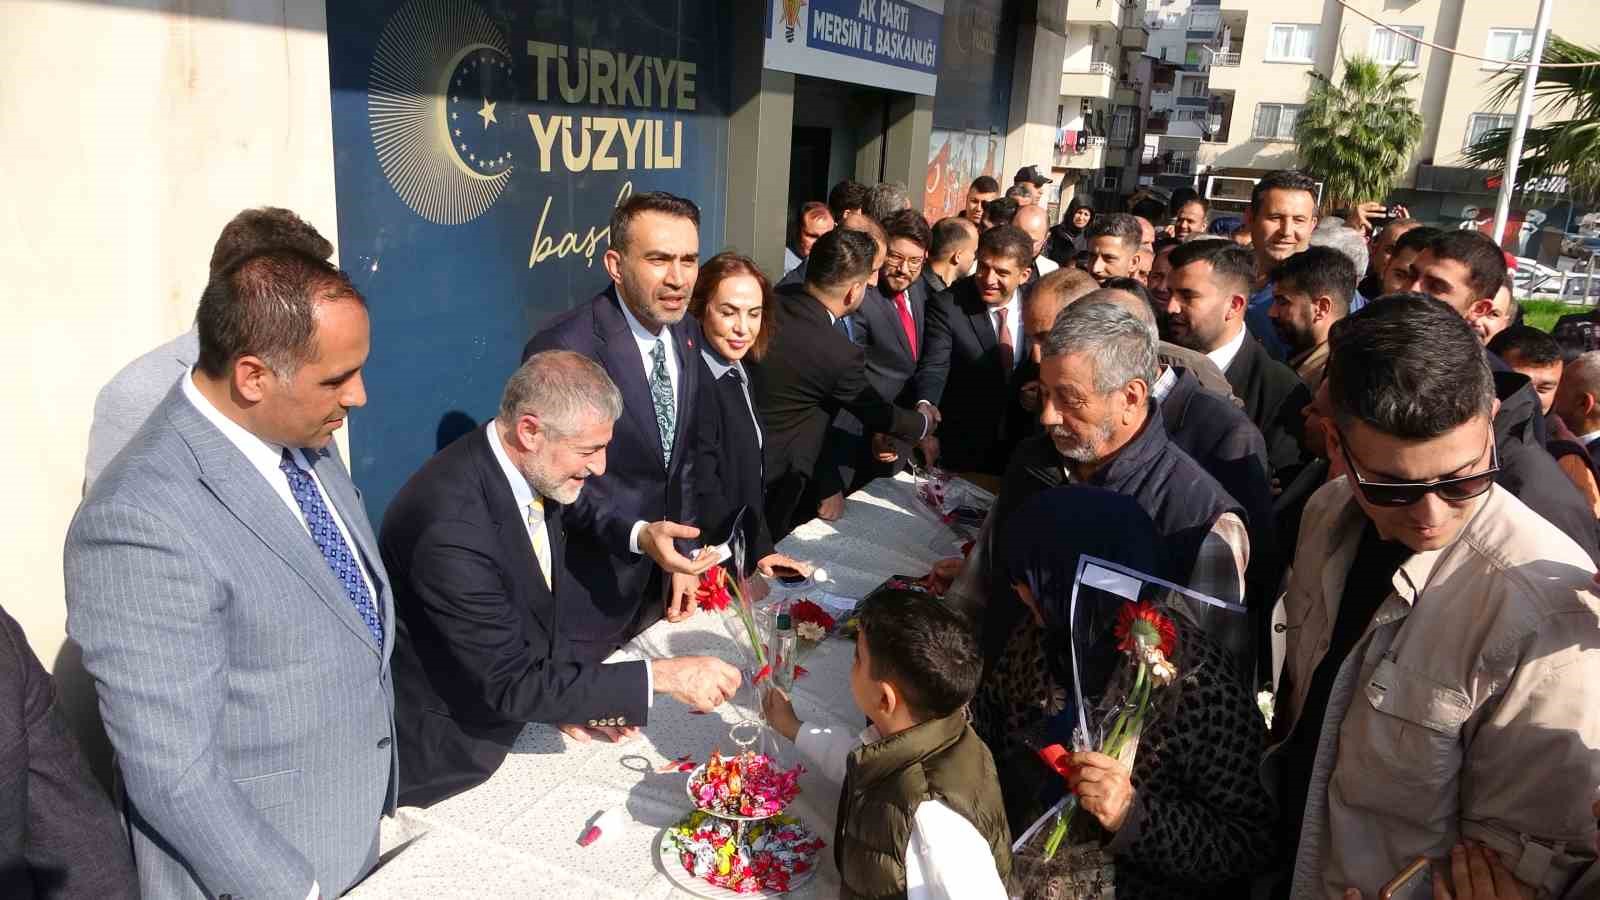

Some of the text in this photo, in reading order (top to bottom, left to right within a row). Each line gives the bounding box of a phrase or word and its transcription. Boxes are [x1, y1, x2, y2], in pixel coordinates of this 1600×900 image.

[813, 10, 861, 49] MERSİN
[863, 25, 873, 52] İL
[876, 27, 936, 67] BAŞKANLIĞI
[858, 0, 909, 32] AK PARTİ
[527, 40, 696, 110] TÜRKİYE
[528, 114, 682, 172] YÜZYILI
